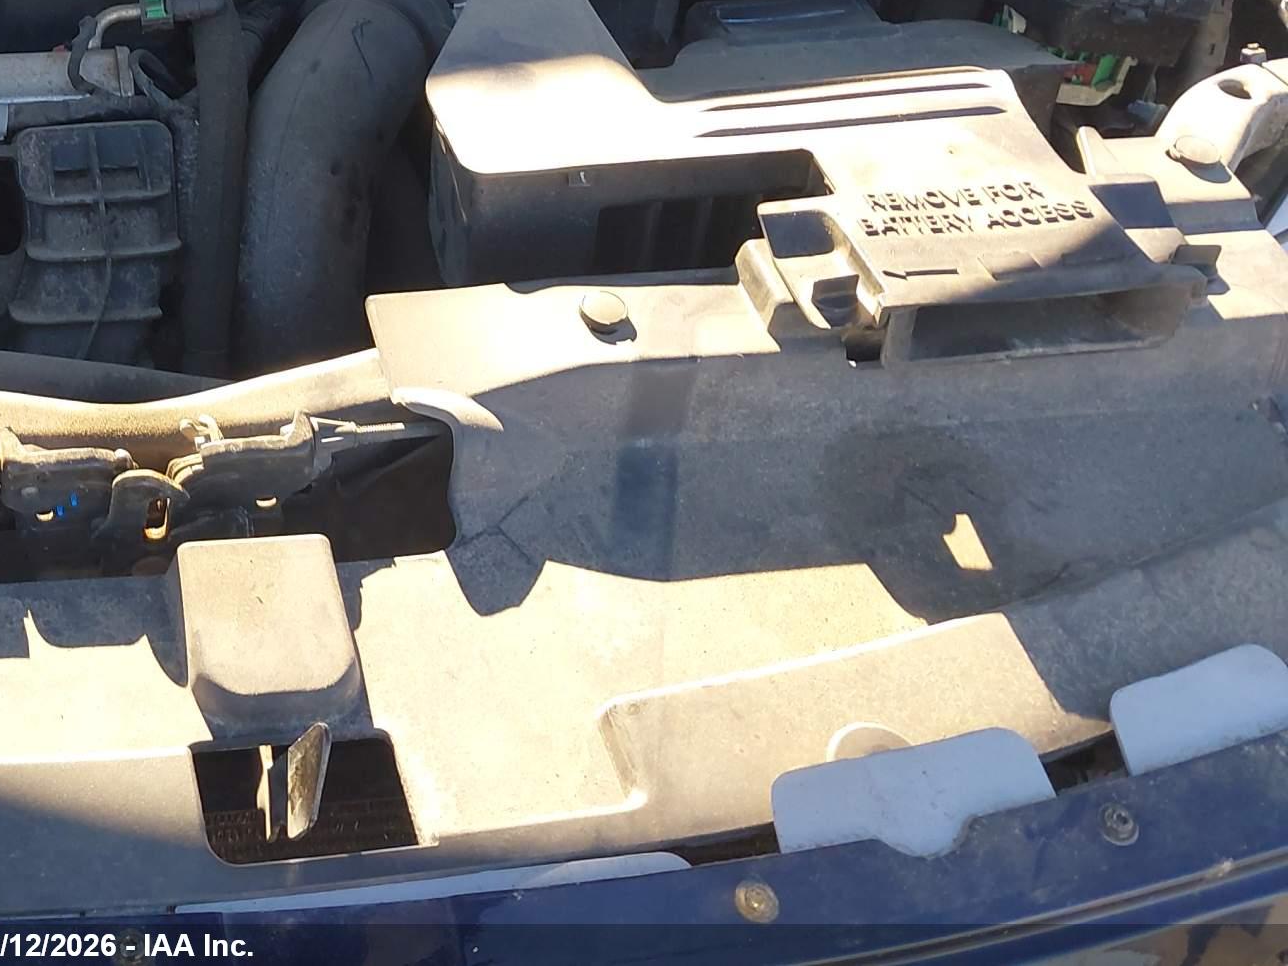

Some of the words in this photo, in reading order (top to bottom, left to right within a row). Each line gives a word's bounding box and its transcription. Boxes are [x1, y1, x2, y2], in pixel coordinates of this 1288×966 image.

[863, 185, 983, 213] REMOVE
[980, 180, 1046, 205] FOR
[856, 212, 976, 237] BATTERY
[986, 199, 1096, 231] ACCESS
